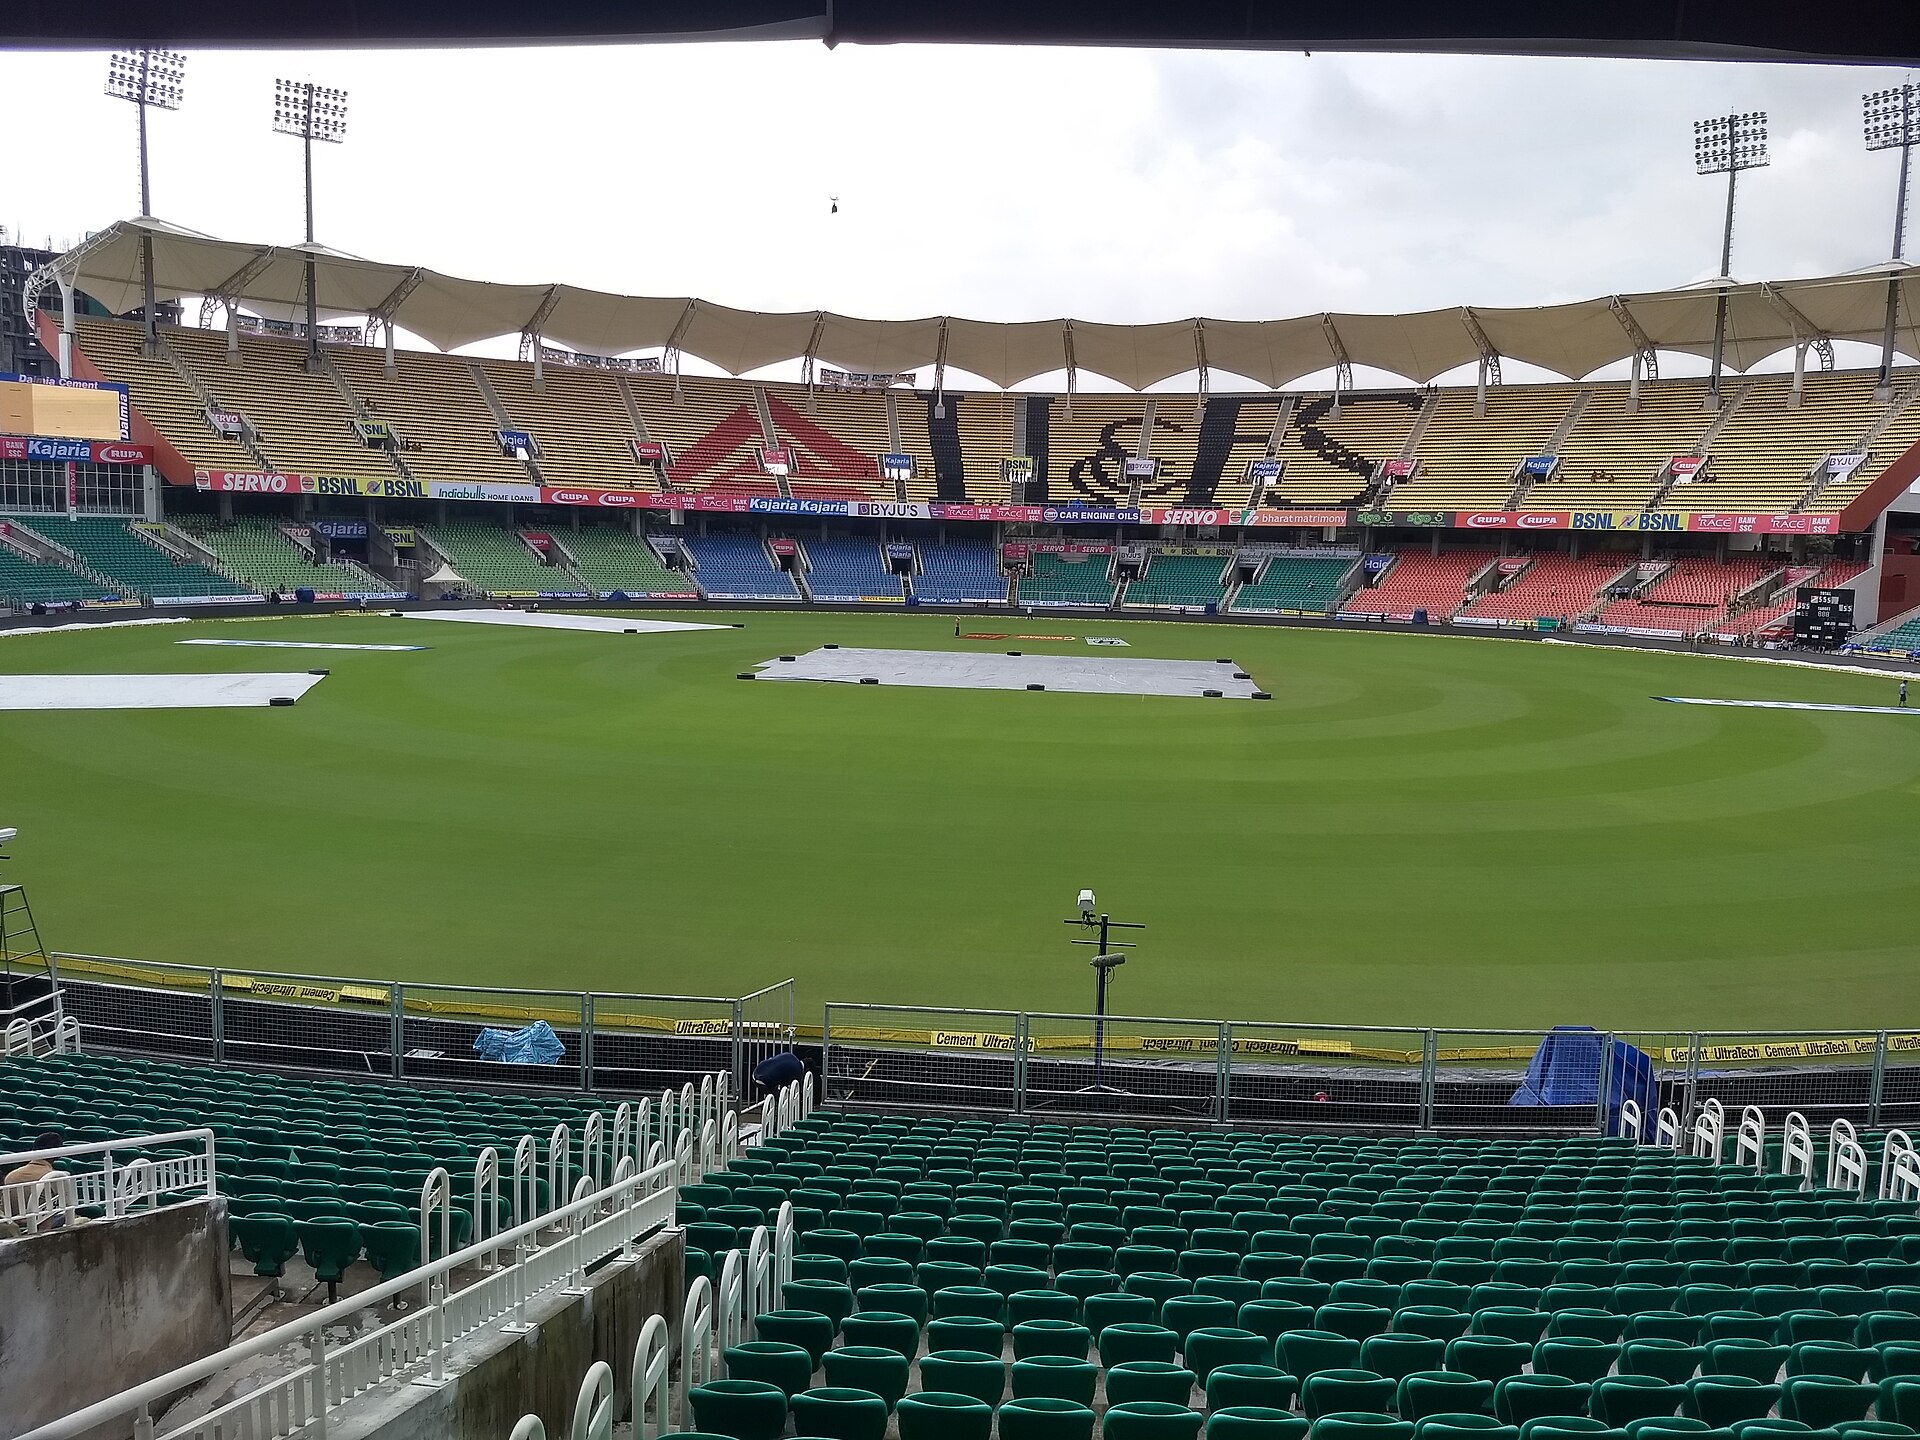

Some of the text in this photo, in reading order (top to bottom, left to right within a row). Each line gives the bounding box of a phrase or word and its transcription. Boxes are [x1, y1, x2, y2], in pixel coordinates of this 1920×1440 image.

[58, 378, 99, 390] Cement
[119, 394, 129, 439] Dalmia
[6, 441, 24, 450] BANK
[28, 440, 91, 458] Kajaria
[8, 450, 22, 458] SSC
[111, 450, 144, 459] RUPA
[1006, 459, 1032, 470] BSNL
[1526, 461, 1551, 469] Kajari
[223, 473, 287, 492] SERVO
[318, 477, 428, 497] BSNL BSNL
[439, 485, 486, 500] Indiabulls
[511, 494, 534, 502] LOANS
[561, 493, 636, 503] RUPA RUPA
[750, 498, 848, 514] Kajaria Kajaria
[871, 503, 918, 517] BYJU'S
[1060, 511, 1079, 519] CAR
[1081, 512, 1115, 520] ENGINE
[1162, 510, 1218, 524] SERVO
[1477, 516, 1506, 524] RUPA
[1738, 516, 1756, 524] BANK
[1812, 517, 1831, 525] BANK
[1572, 513, 1684, 531] BSNL BSNL
[1739, 524, 1753, 532] SSC
[1813, 525, 1827, 533] SSC
[1182, 548, 1198, 556] BSNL
[1364, 560, 1388, 569] Haie
[250, 981, 335, 1000] Cement UltraTech
[676, 1020, 729, 1035] UltraTech
[936, 1032, 977, 1047] Cement
[1142, 1038, 1298, 1056] UltraTech Cent UltraTech
[1714, 1046, 1760, 1060] UltraTech
[1764, 1043, 1801, 1057] Cement
[1806, 1040, 1850, 1056] UltraTech
[1854, 1039, 1888, 1052] Cem
